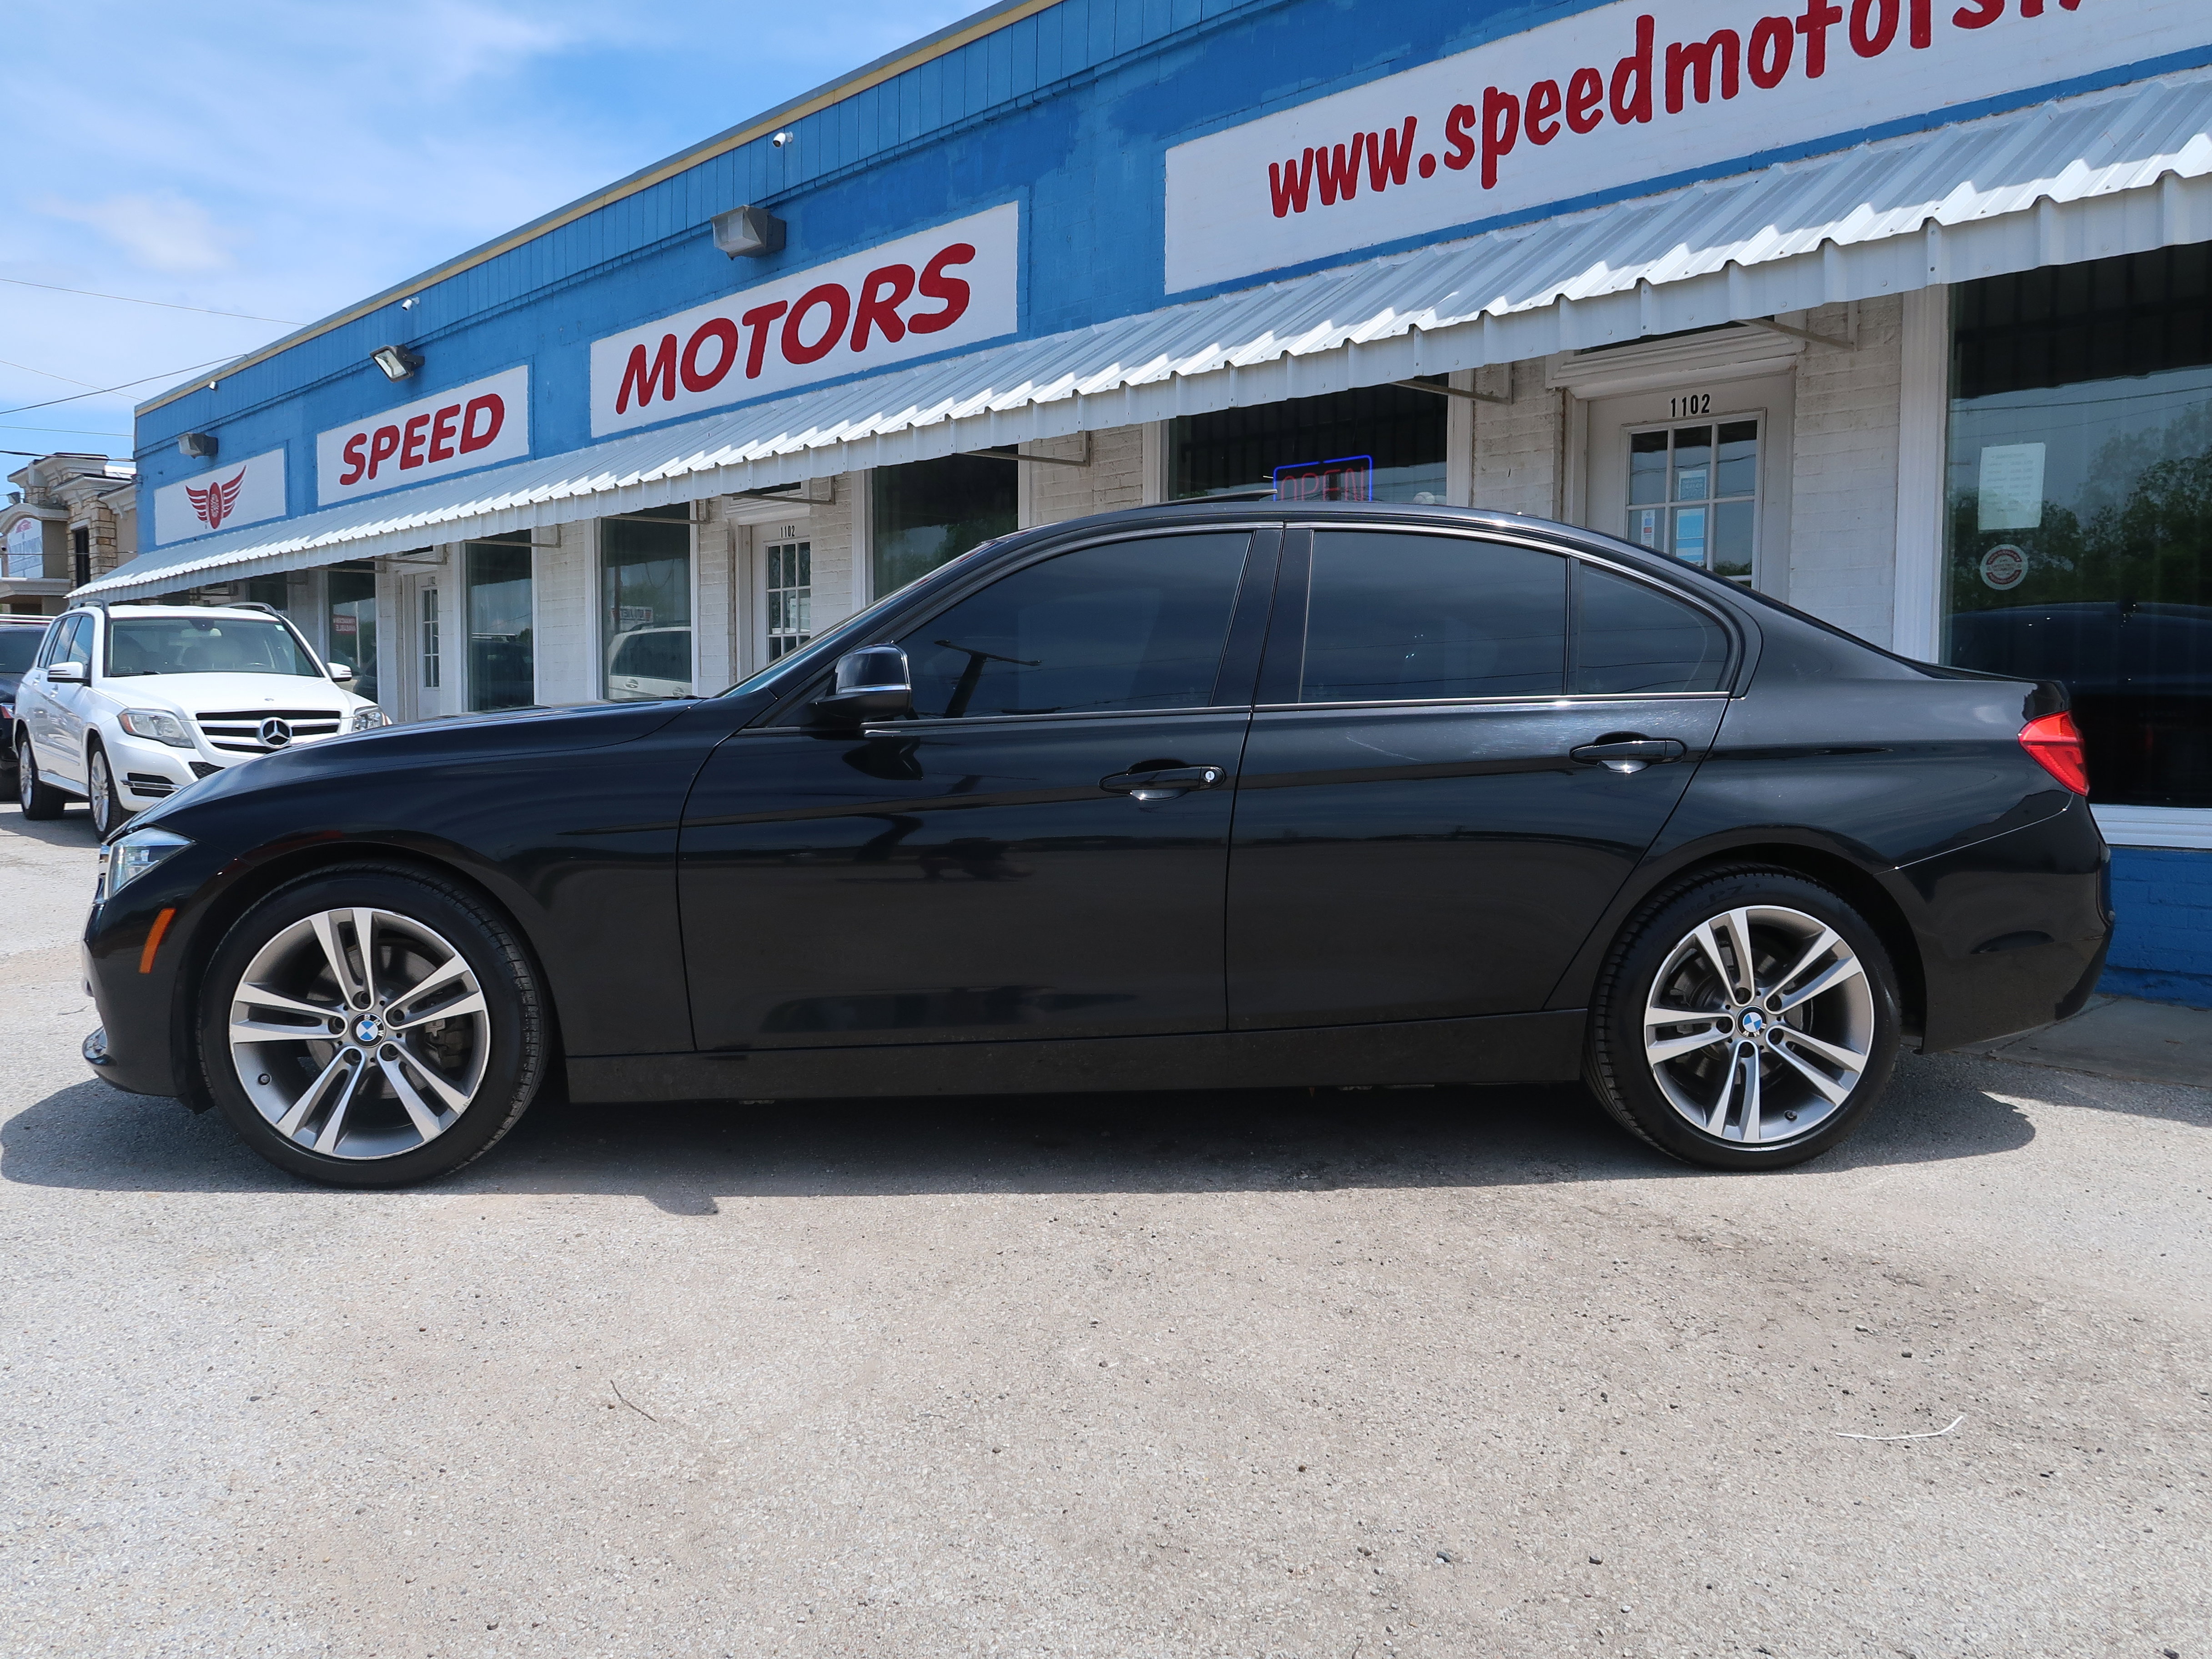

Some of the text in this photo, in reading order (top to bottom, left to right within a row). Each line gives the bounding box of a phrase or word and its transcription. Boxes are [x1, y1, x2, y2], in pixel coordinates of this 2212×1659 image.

[616, 243, 976, 415] MOTORS
[1671, 393, 1710, 417] 1102
[340, 393, 505, 485] SPEED
[1281, 467, 1365, 501] OPEN
[780, 525, 795, 538] 1102
[363, 1014, 385, 1037] BMW
